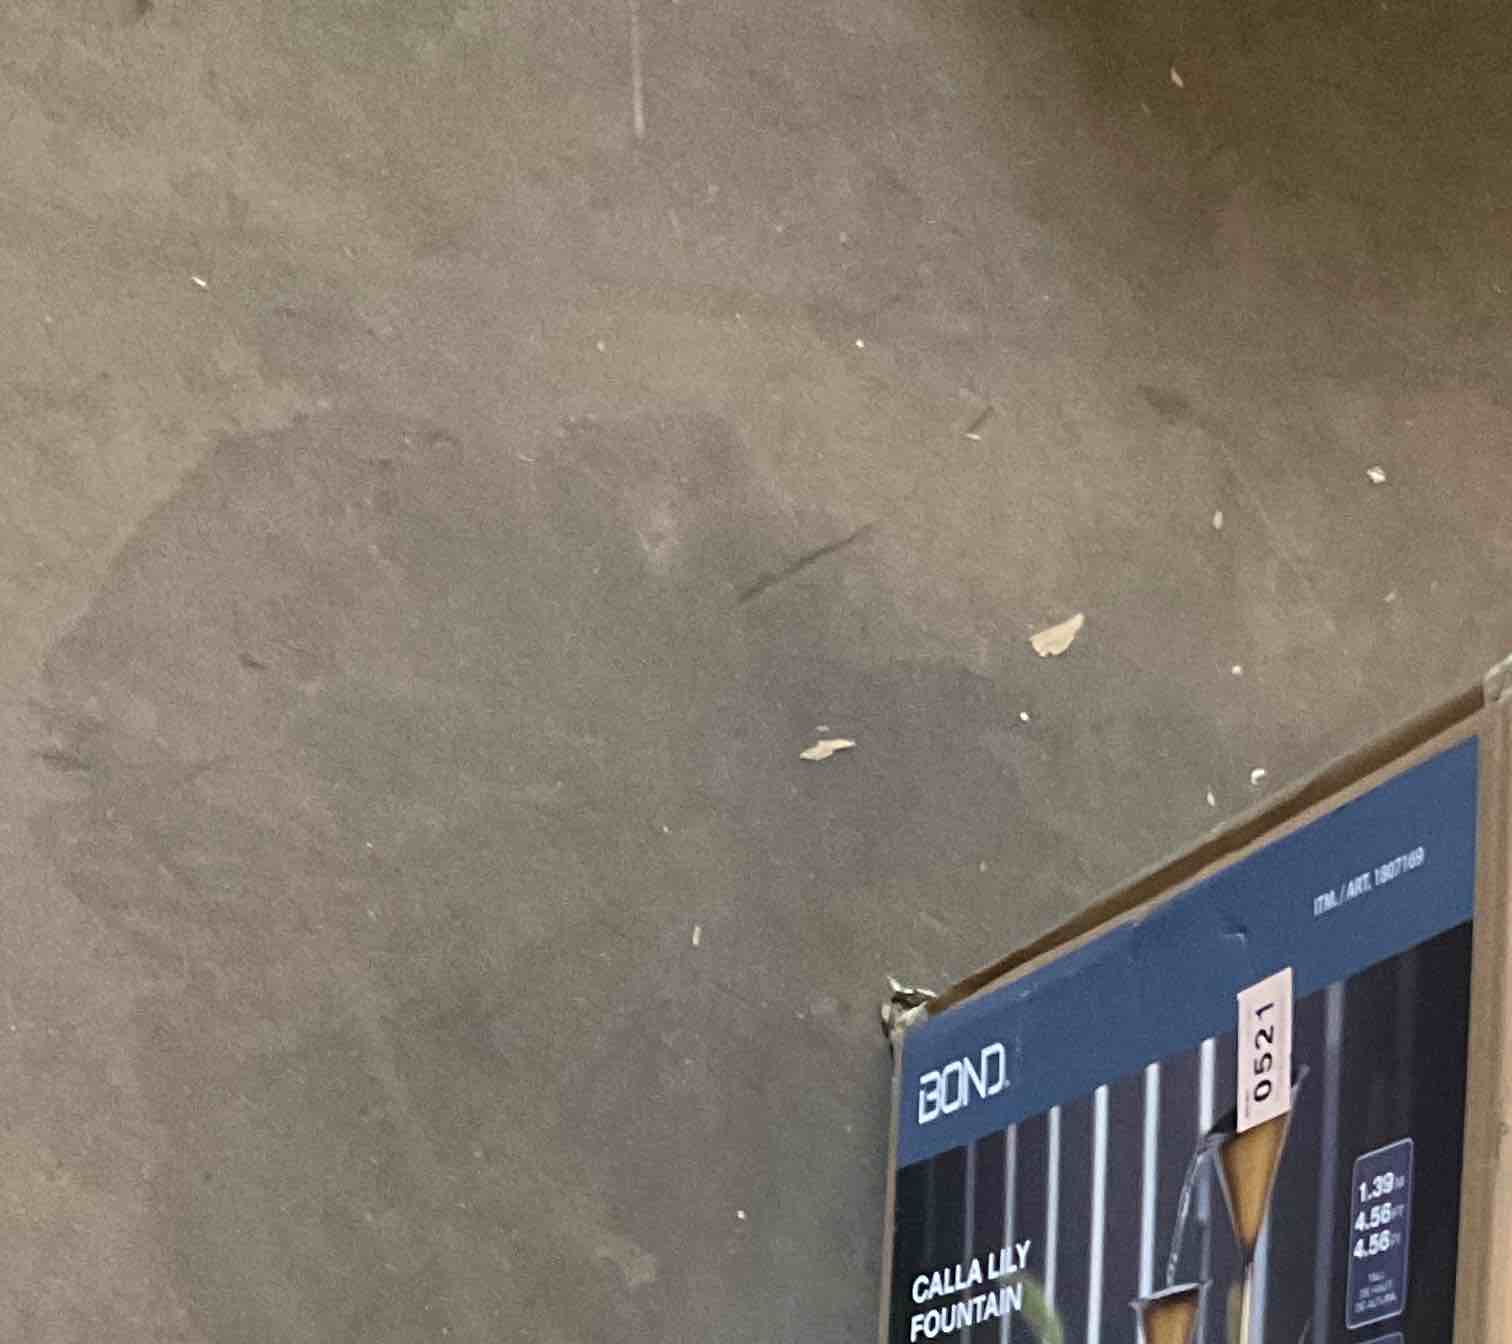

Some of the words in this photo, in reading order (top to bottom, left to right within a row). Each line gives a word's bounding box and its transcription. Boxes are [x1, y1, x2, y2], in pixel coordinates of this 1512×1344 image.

[918, 1042, 1006, 1125] BOND
[1253, 1002, 1275, 1103] 0521
[912, 1257, 982, 1304] CALLA
[988, 1240, 1031, 1279] LILY
[910, 1283, 1024, 1343] FOUNTAIN
